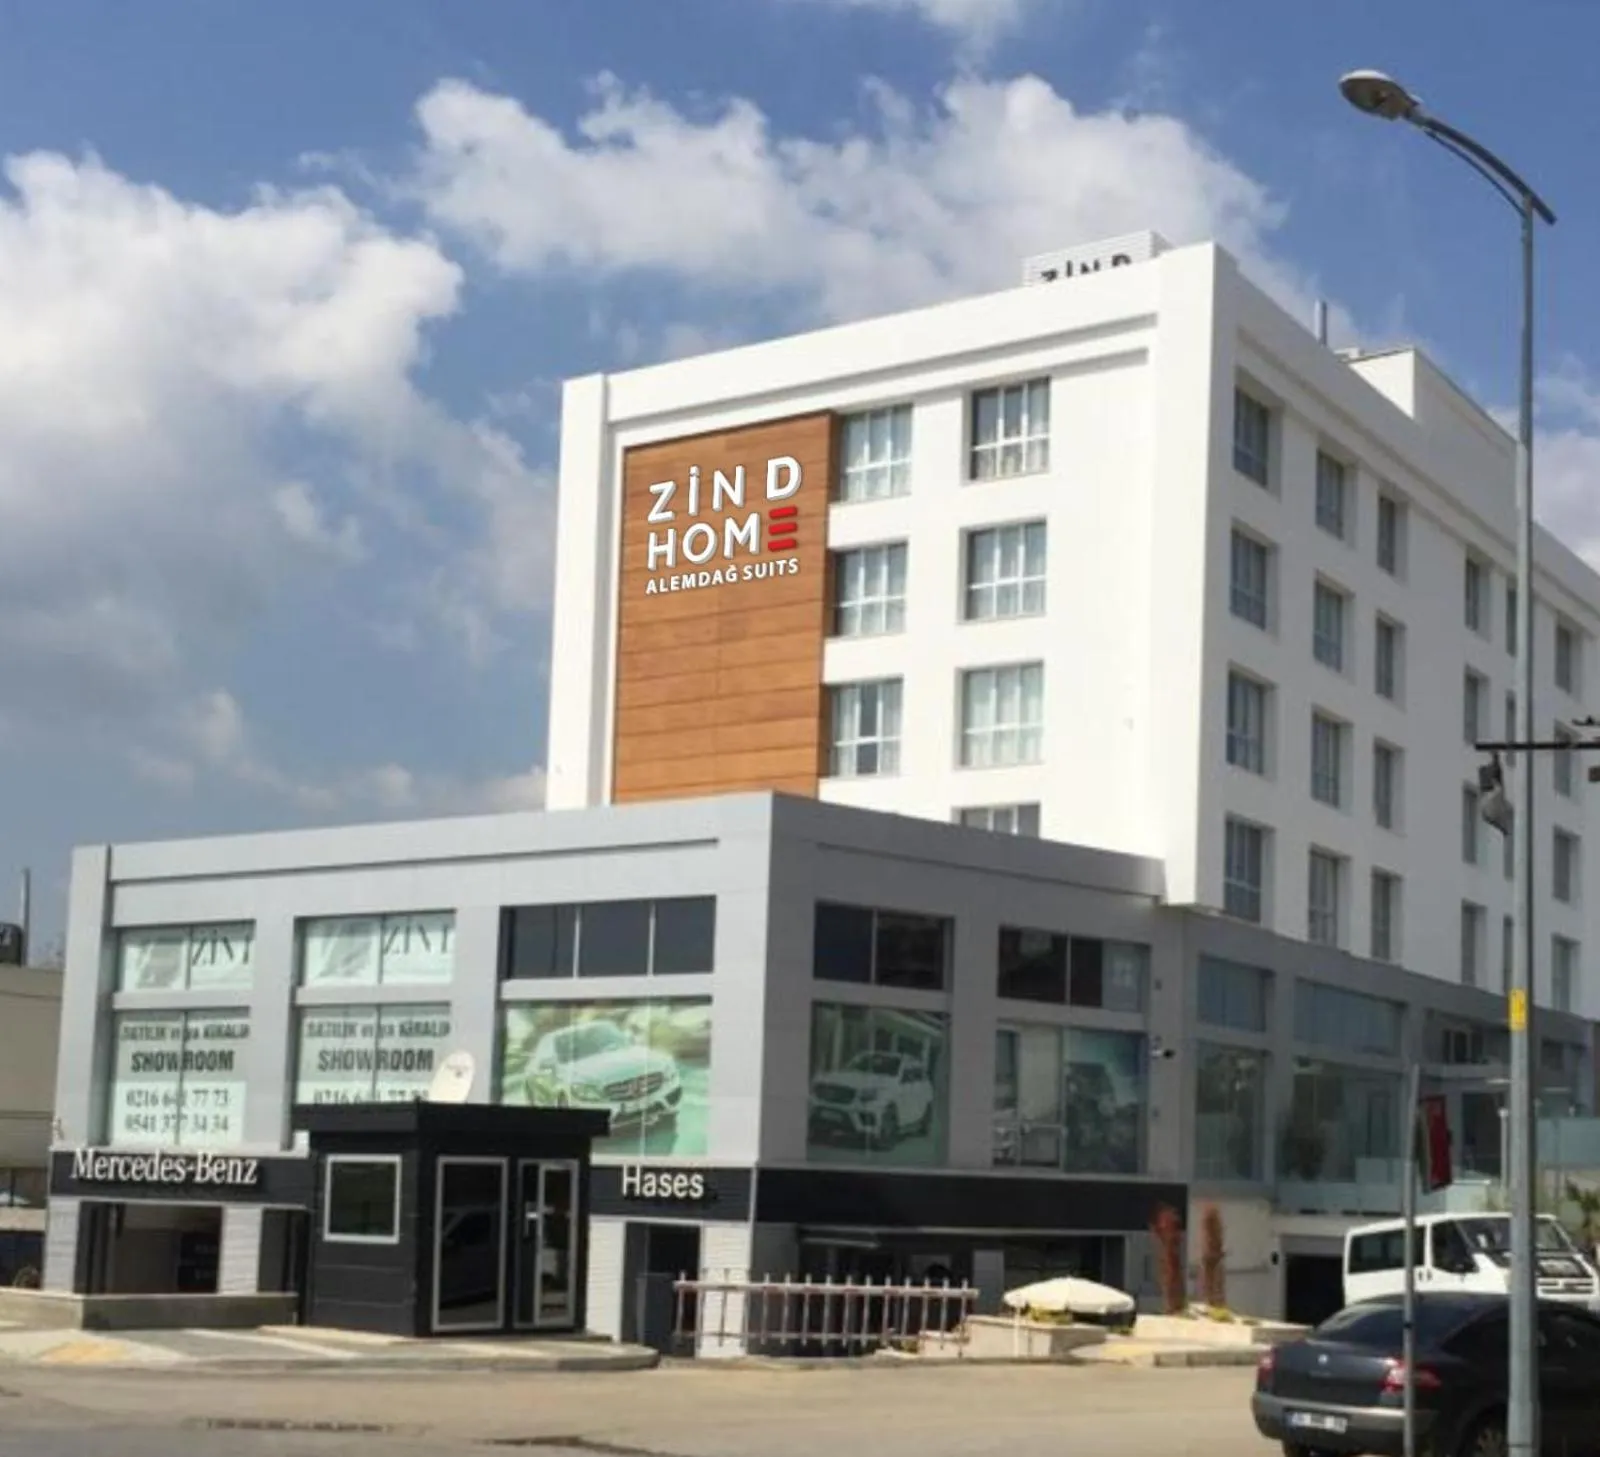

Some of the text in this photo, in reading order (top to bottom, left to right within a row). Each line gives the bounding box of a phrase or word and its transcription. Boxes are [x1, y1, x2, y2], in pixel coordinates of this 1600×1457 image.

[647, 504, 798, 571] HOME
[645, 558, 799, 595] ALEMDAĞ SUITS
[131, 1049, 233, 1072] SHOWROOM
[318, 1048, 434, 1072] SHOWROOM
[70, 1148, 260, 1184] Mercedes-Benz
[621, 1163, 704, 1199] Hases
